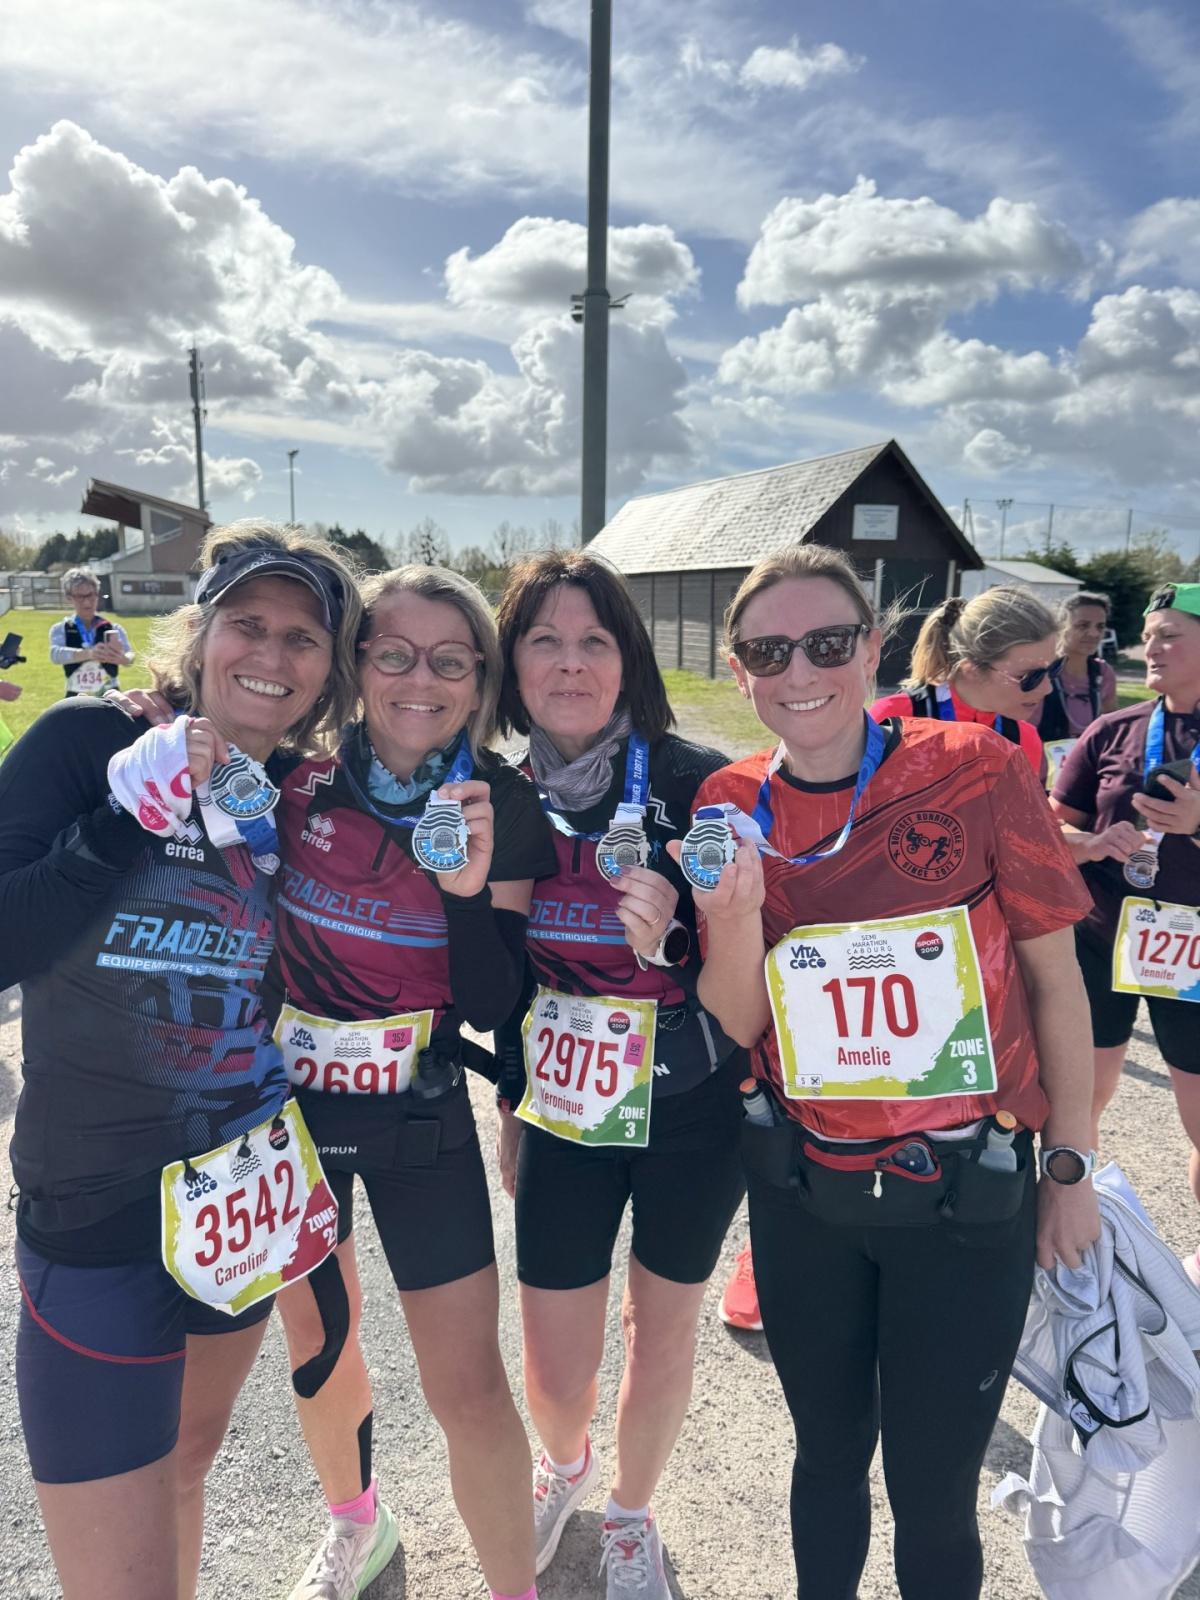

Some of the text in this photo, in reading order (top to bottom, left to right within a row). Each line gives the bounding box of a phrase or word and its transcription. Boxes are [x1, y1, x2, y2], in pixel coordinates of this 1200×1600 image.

[301, 830, 332, 852] errea
[165, 842, 205, 862] errea
[104, 912, 258, 961] FRADELEC
[320, 918, 383, 940] ELECTRIQUES
[540, 930, 599, 943] ELECTRIQUES
[790, 944, 821, 959] VITA
[846, 945, 893, 955] CABOURG
[851, 940, 888, 948] MARATHON
[916, 938, 940, 947] SPORT
[920, 946, 940, 954] 2000
[1137, 928, 1200, 970] 1270
[101, 955, 193, 974] EQUIPEMENTS
[790, 958, 826, 970] COCO
[1140, 966, 1176, 980] Jennifer
[822, 973, 919, 1038] 170
[289, 1036, 317, 1050] COCO
[293, 1027, 314, 1042] VITA
[837, 1046, 891, 1067] Amelie
[949, 1038, 985, 1058] ZONE
[536, 1027, 619, 1097] 2975
[294, 1057, 398, 1094] 2691
[961, 1060, 978, 1085] 3
[540, 1085, 584, 1116] Veronique
[618, 1106, 646, 1119] ZONE
[625, 1122, 636, 1139] 3
[317, 1145, 358, 1155] IPRUN
[186, 1179, 218, 1202] COCO
[195, 1160, 300, 1267] 3542
[306, 1205, 337, 1234] ZONE
[323, 1226, 336, 1248] 2
[214, 1248, 269, 1287] Caroline
